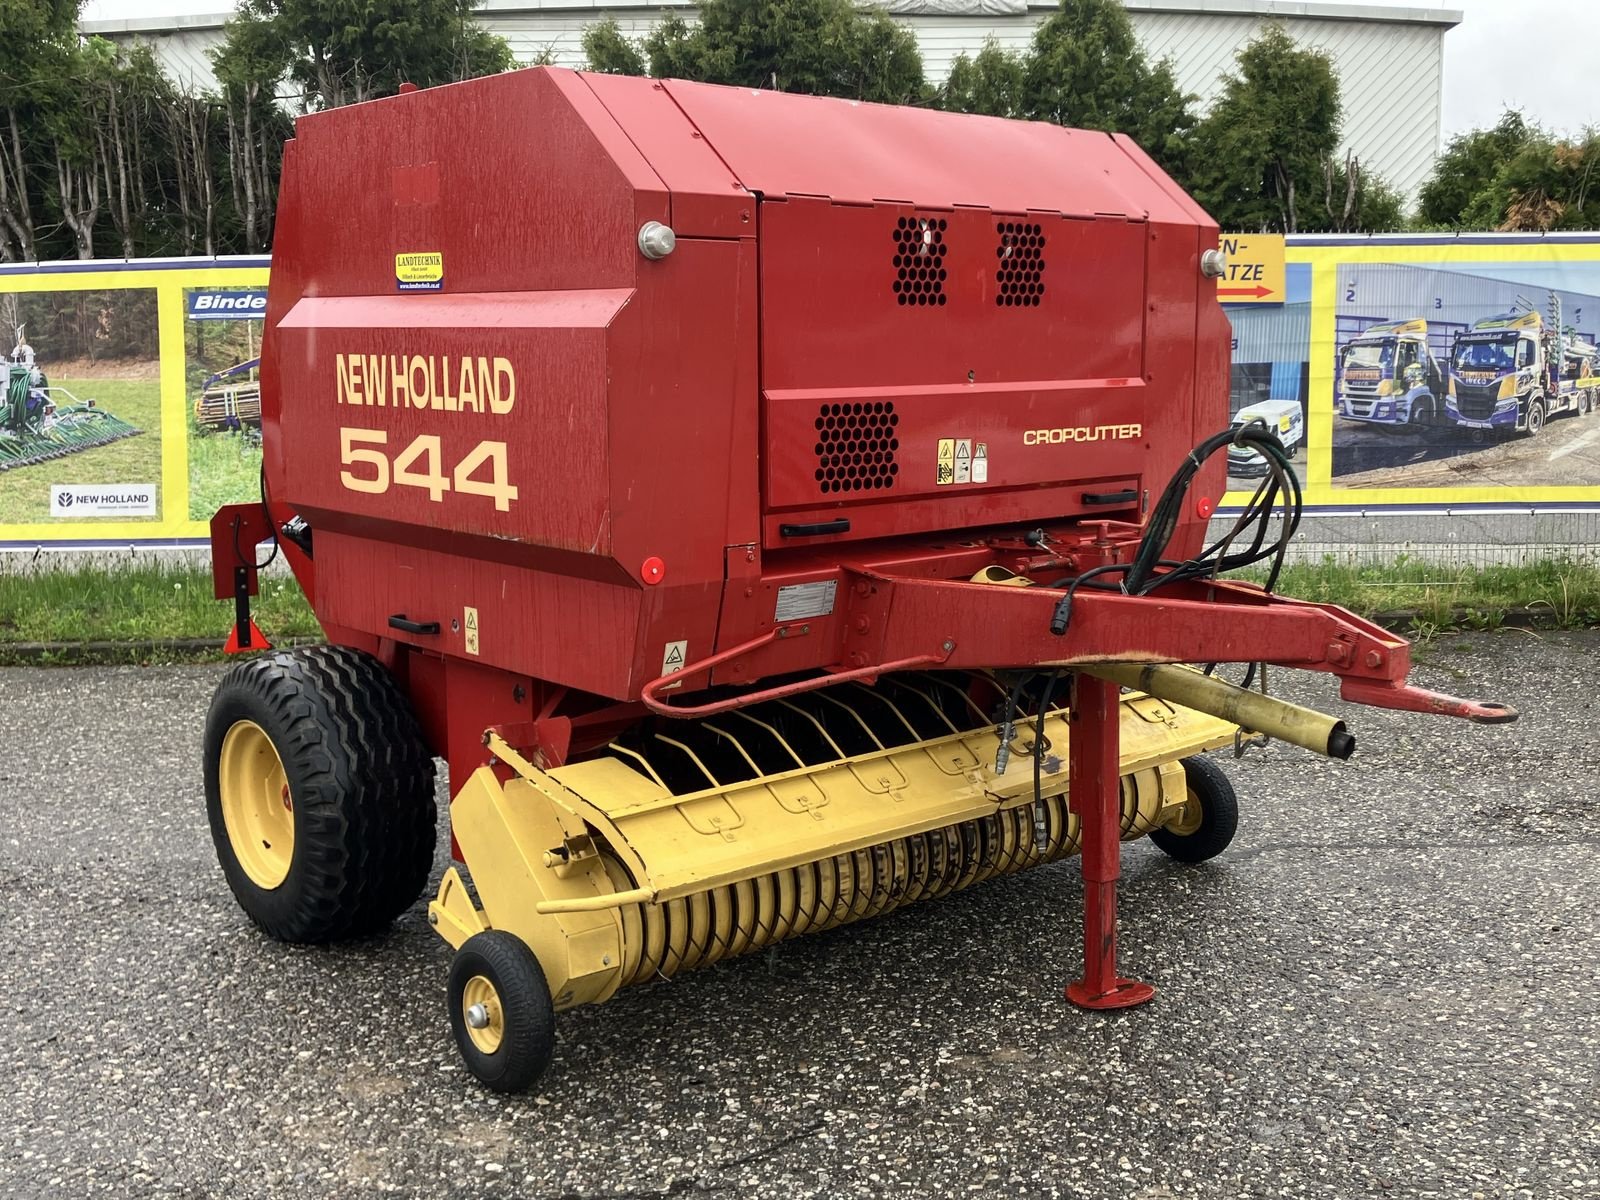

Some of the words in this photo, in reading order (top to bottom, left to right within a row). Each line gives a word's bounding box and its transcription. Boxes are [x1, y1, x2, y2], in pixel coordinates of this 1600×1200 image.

[1218, 239, 1248, 255] N-
[398, 256, 440, 266] LANDTECHNIK
[1346, 289, 1356, 302] 2
[1434, 298, 1443, 309] 3
[336, 353, 387, 407] NEW
[390, 354, 516, 415] HOLLAND
[1024, 424, 1142, 446] CROPCUTTER
[340, 426, 519, 513] 544
[76, 495, 99, 504] NEW
[101, 494, 149, 504] HOLLAND
